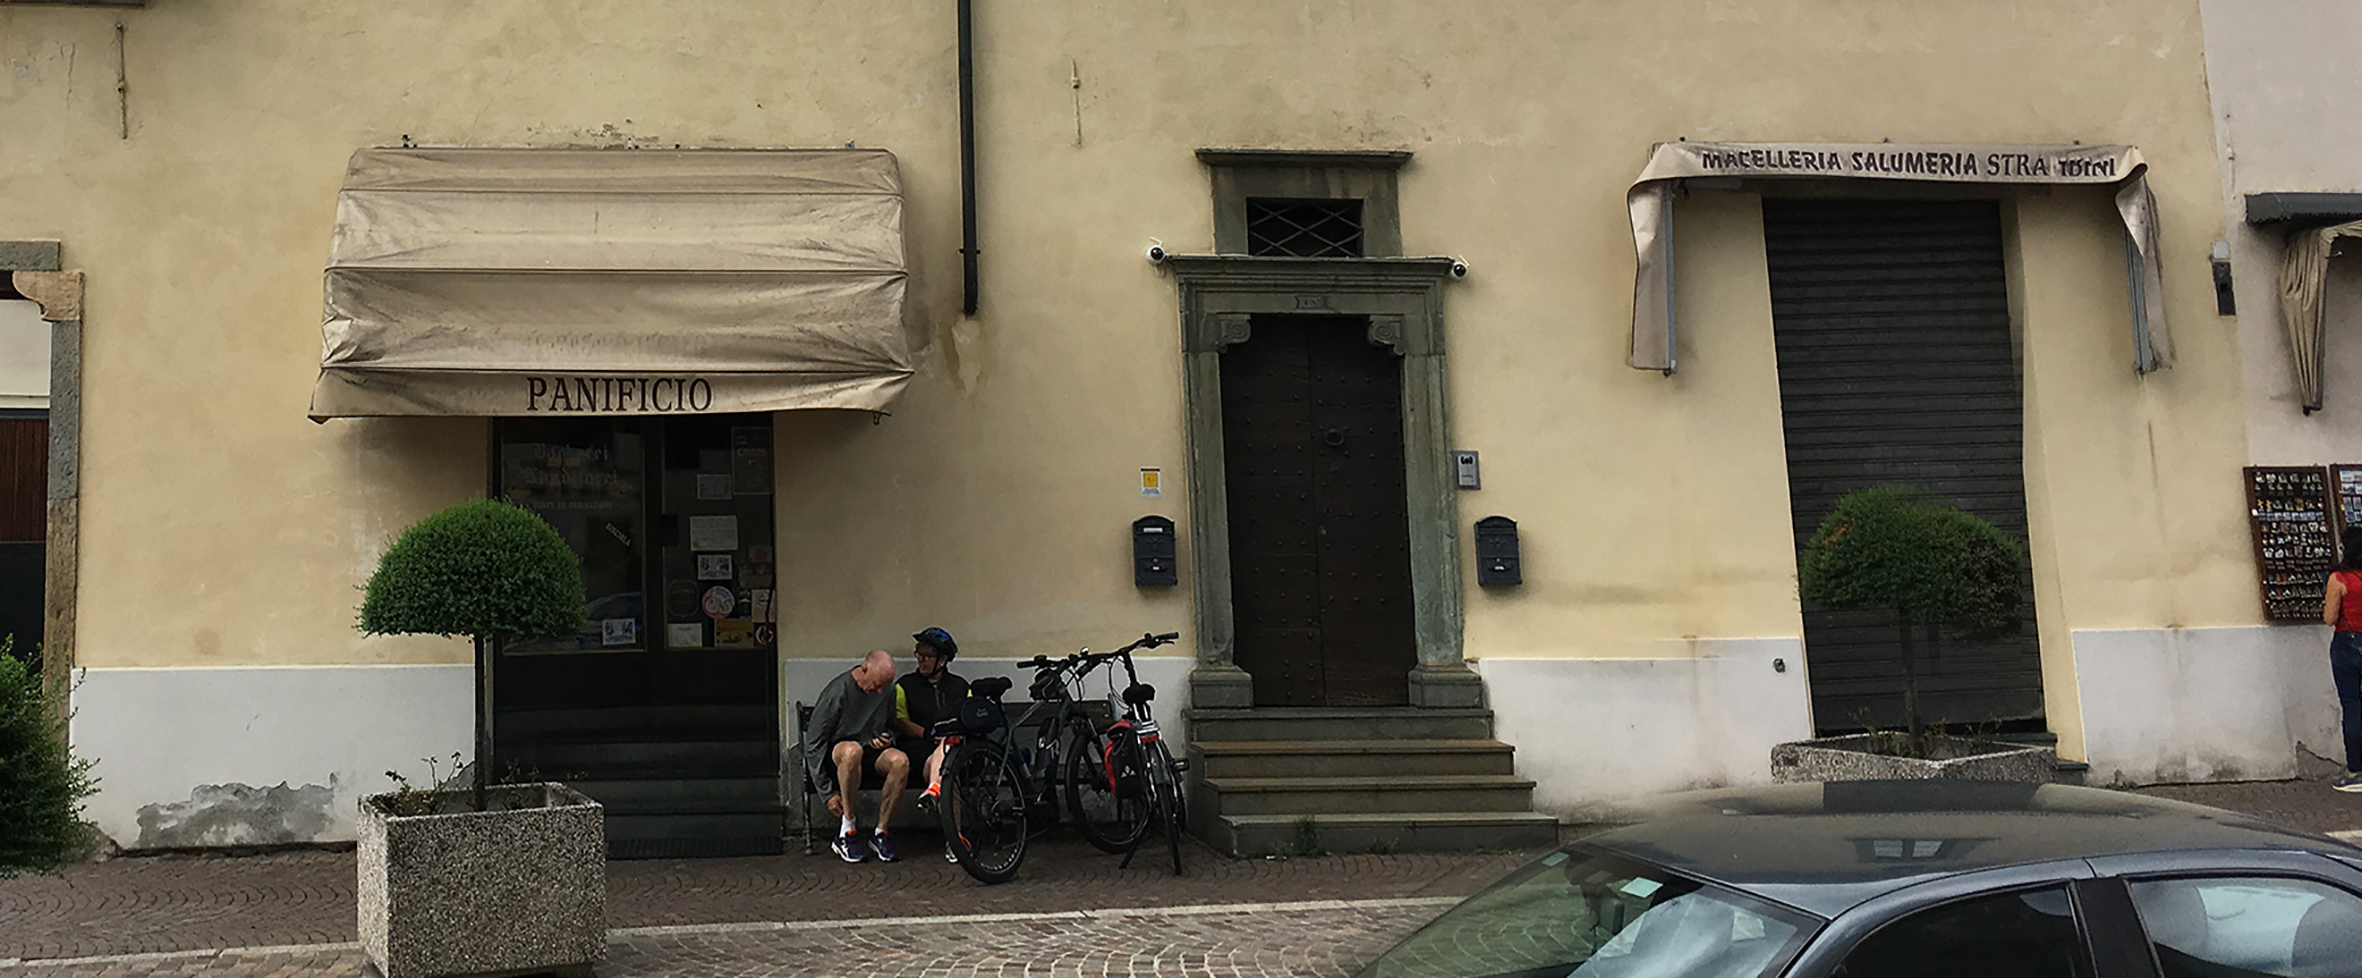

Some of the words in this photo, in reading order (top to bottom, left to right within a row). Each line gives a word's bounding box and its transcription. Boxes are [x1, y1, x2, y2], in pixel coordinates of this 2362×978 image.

[1702, 149, 1842, 171] MACELLERIA
[1851, 151, 1978, 177] SALUMERIA
[526, 377, 712, 412] PANIFICIO
